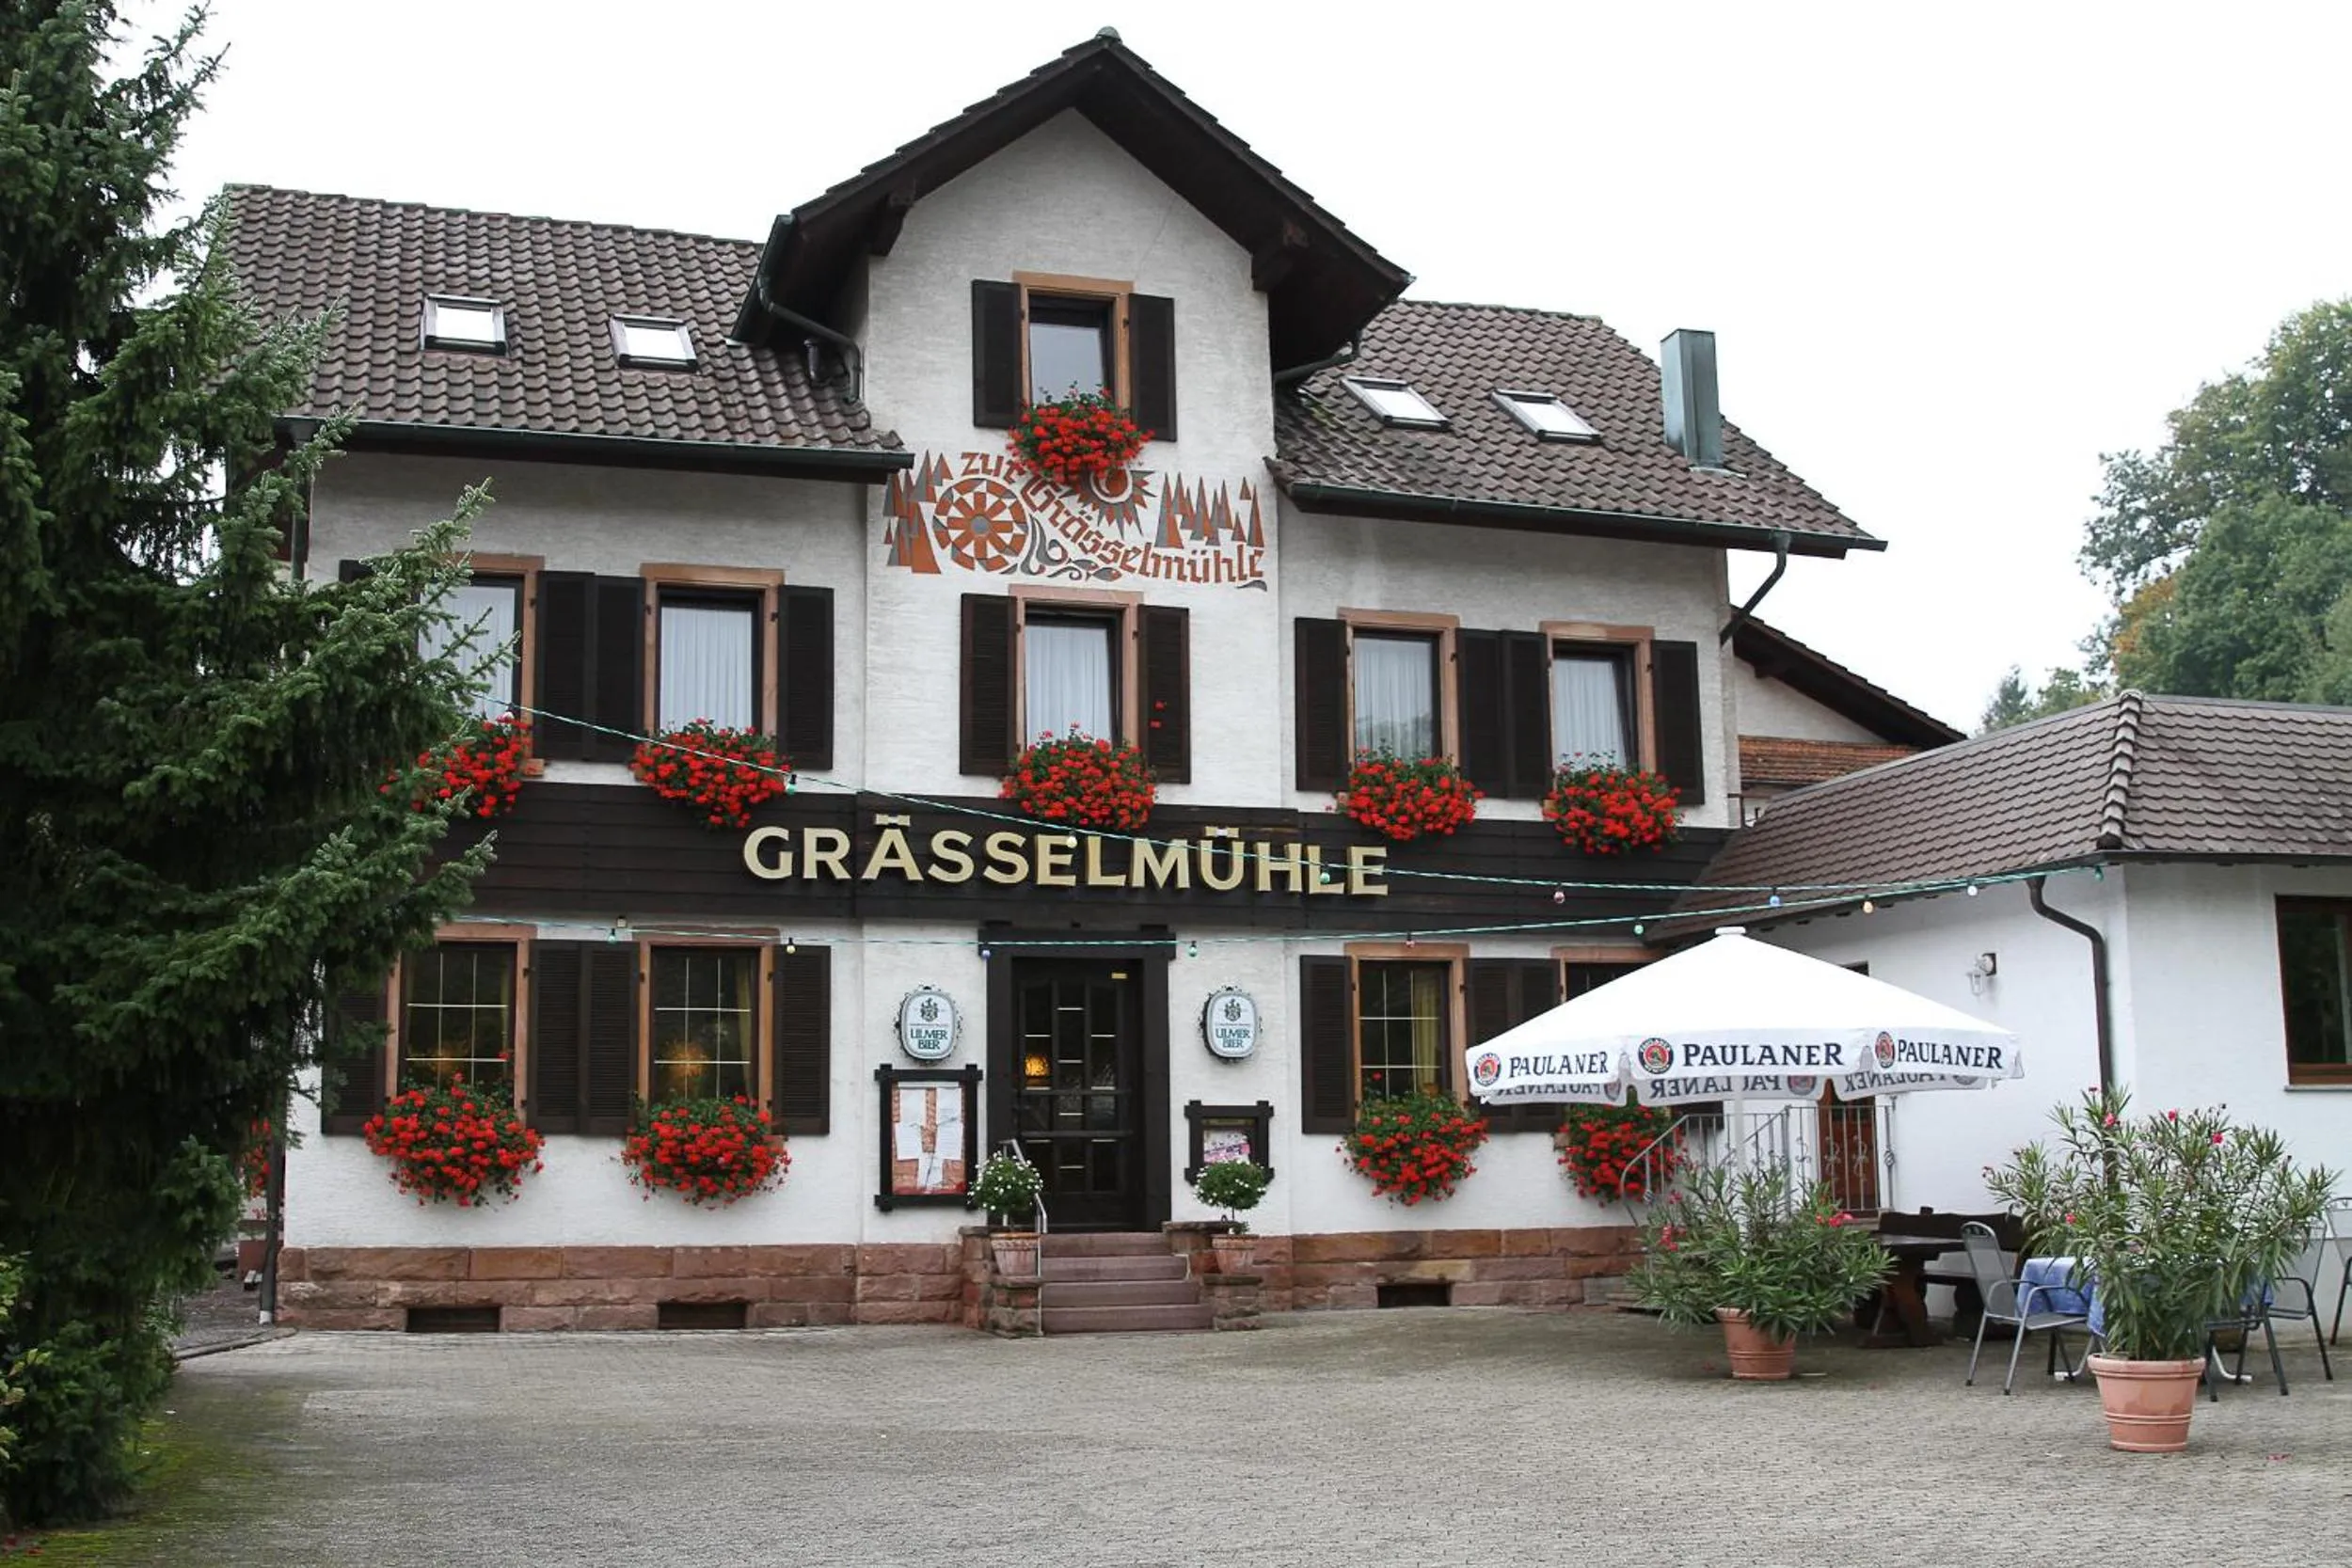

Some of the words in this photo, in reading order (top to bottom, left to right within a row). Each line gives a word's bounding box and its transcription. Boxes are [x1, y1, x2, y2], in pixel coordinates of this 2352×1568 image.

[742, 814, 1390, 896] GRÄSSELMÜHLE
[910, 1027, 948, 1040] ULMER
[918, 1039, 941, 1050] BIER
[1216, 1027, 1251, 1039] ULMER
[1509, 1051, 1609, 1079] PAULANER
[1682, 1042, 1844, 1068] PAULANER
[1898, 1039, 2003, 1069] PAULANER
